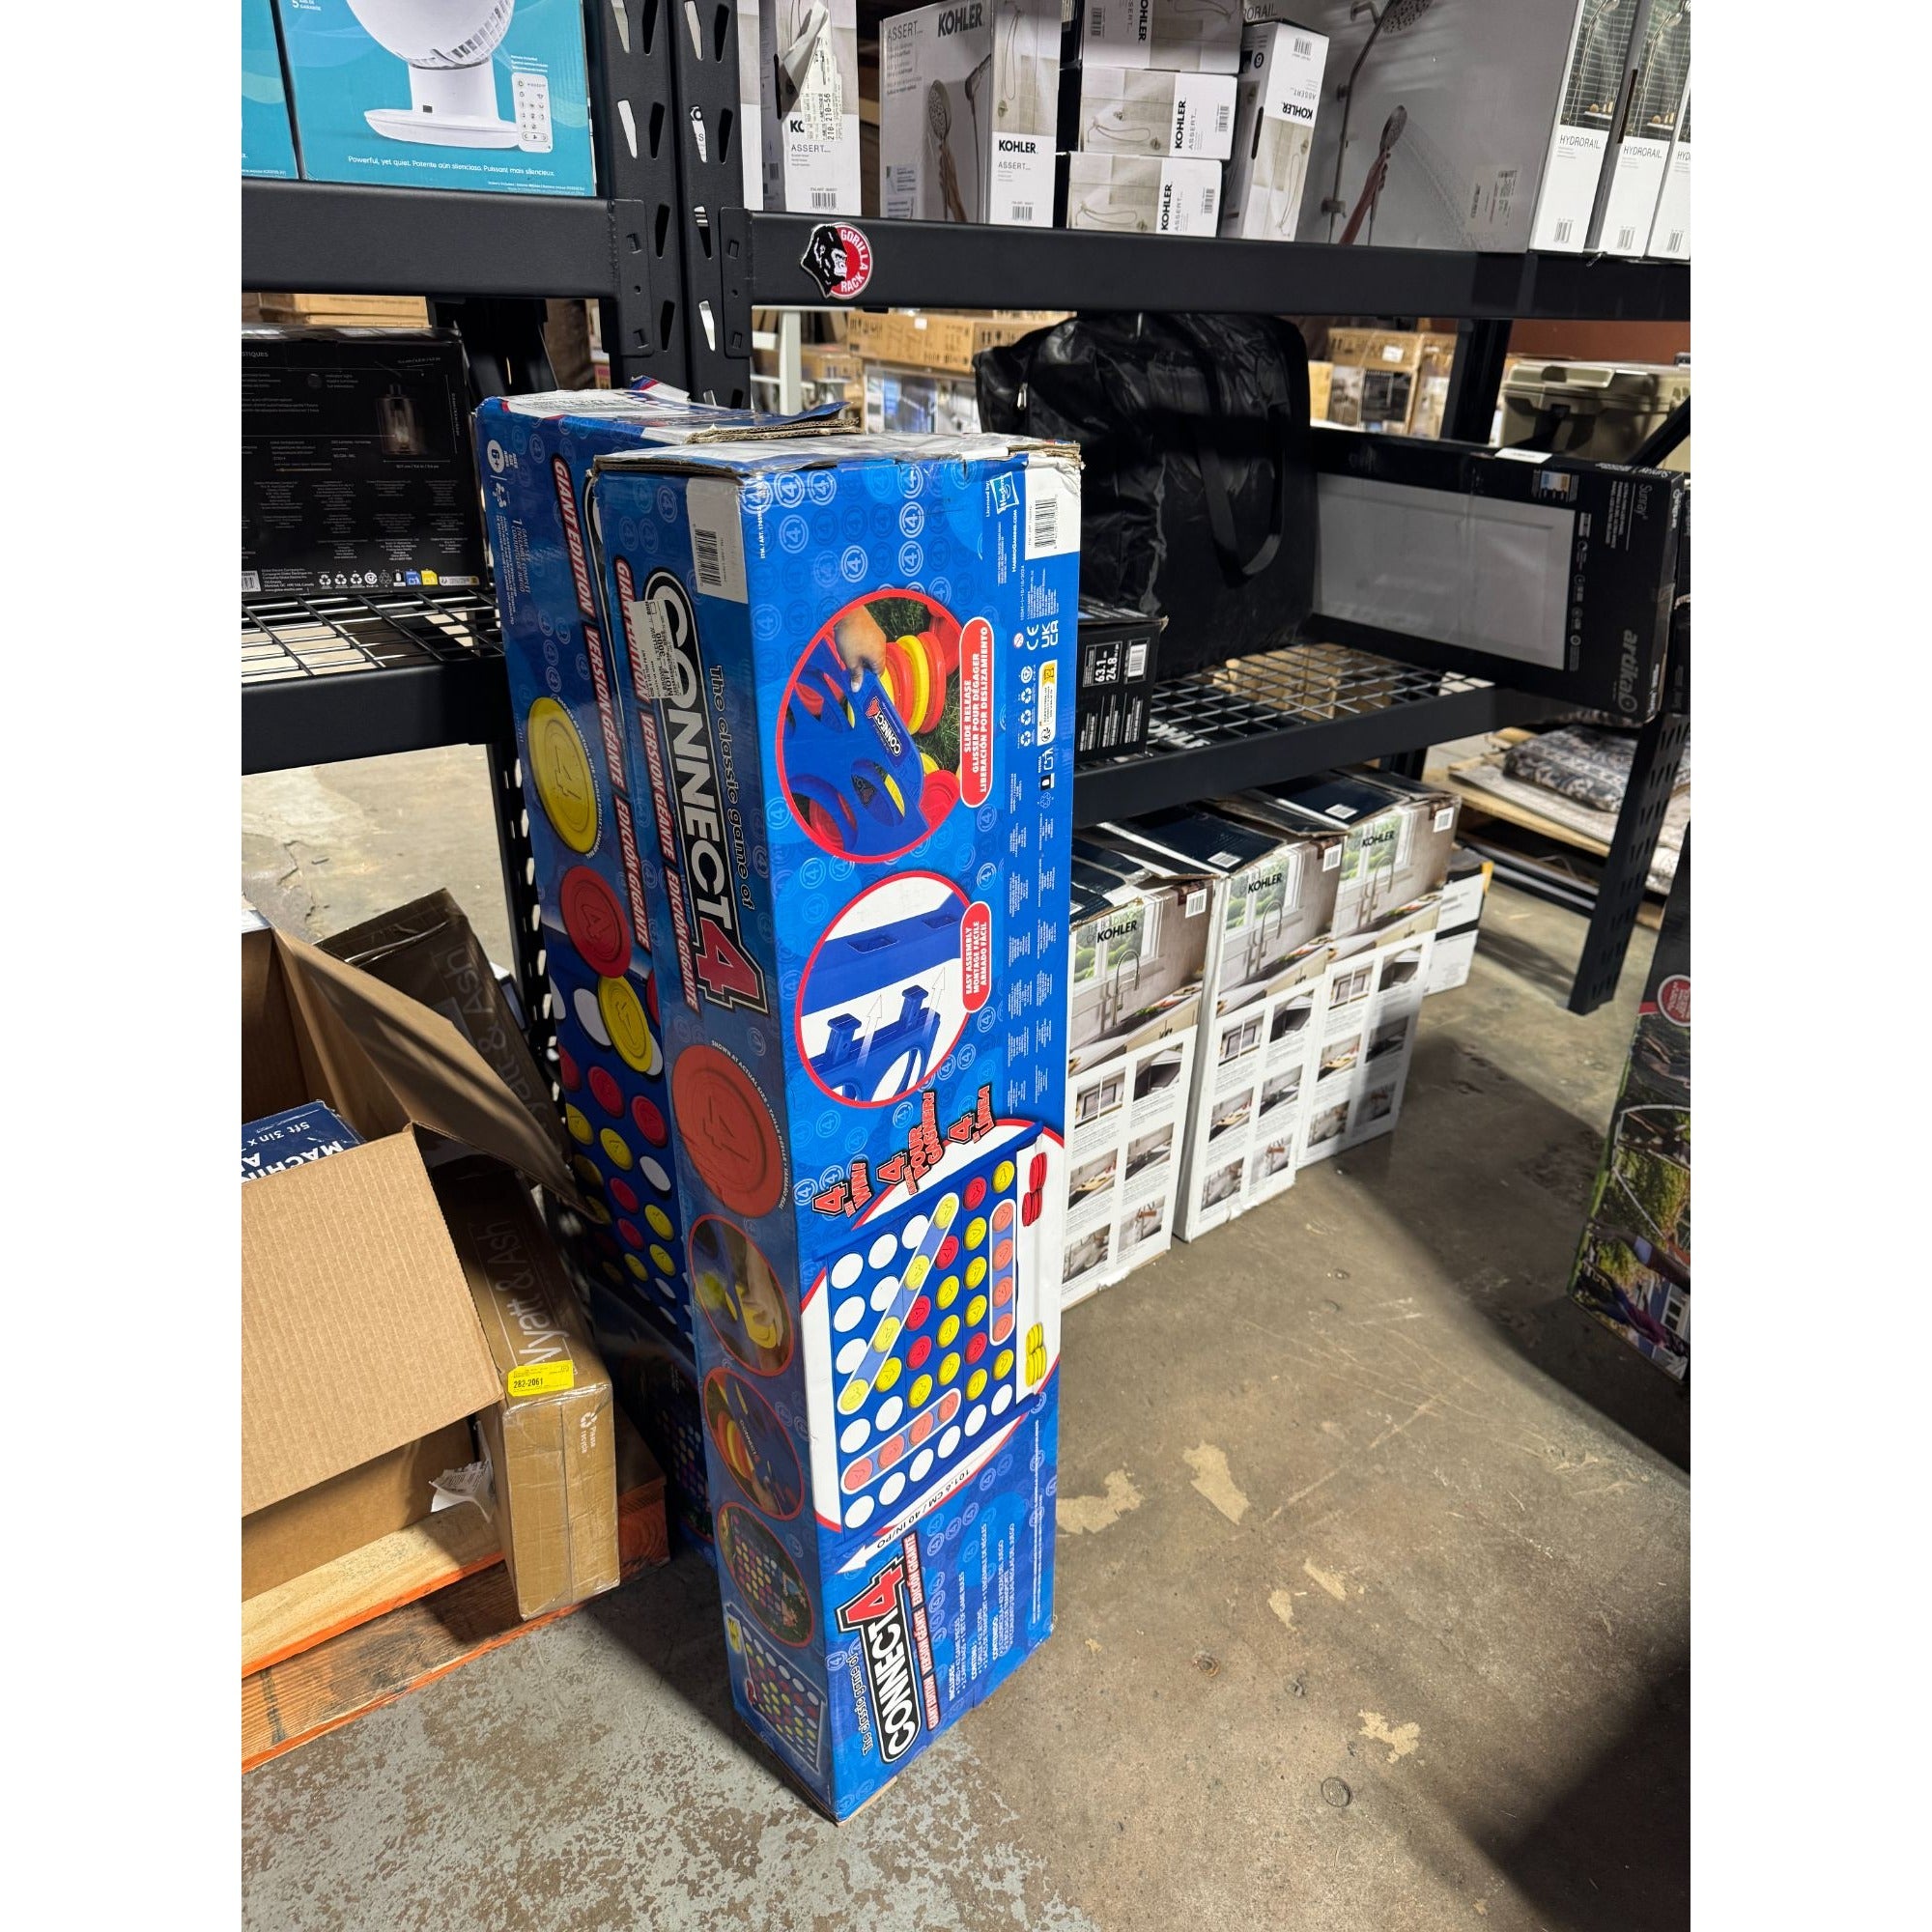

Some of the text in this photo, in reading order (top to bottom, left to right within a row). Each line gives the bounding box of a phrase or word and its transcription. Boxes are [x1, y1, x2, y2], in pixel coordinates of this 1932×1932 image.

[888, 20, 918, 40] ASSERT
[938, 3, 982, 38] KOHLER
[1138, 0, 1149, 41] OHLER
[1175, 99, 1186, 149] KOHLER
[1282, 101, 1314, 120] KOHLER
[999, 139, 1037, 154] KOHLER
[1560, 134, 1601, 149] HYDRORAIL
[1623, 146, 1662, 158] HYDRORAIL
[348, 156, 380, 165] Powerful,
[412, 159, 437, 168] Potente
[484, 164, 508, 174] Puissant
[998, 161, 1026, 170] ASSERT
[1161, 184, 1172, 231] KOHLER
[840, 229, 868, 270] GORILLA
[840, 271, 866, 293] RACK
[1635, 484, 1652, 518] Sunray
[554, 461, 595, 618] GIANT EDITION
[972, 653, 980, 700] DÉGAGER
[1095, 659, 1107, 682] 63.1
[1106, 657, 1118, 681] 24.8
[585, 627, 626, 791] VERSION GÉANTE
[874, 711, 900, 753] CONNECT
[640, 714, 668, 801] VERSION
[655, 802, 675, 860] GÉANTE
[653, 584, 759, 999] CONNECT 4
[710, 666, 754, 910] The classic game of
[1361, 830, 1395, 847] KOHLER
[615, 796, 651, 952] EDICIÓN GIGANTE
[1247, 872, 1283, 894] KOHLER
[667, 868, 699, 1013] EDICIÓN GIGANTE
[1097, 920, 1137, 943] KOHLER
[712, 1040, 731, 1056] SHOWN
[738, 1062, 757, 1087] ACTUAL
[757, 1086, 768, 1103] SIZE
[769, 1109, 781, 1134] TAILLE
[264, 1127, 285, 1143] 3in
[288, 1121, 310, 1137] 5ft
[909, 1127, 930, 1179] POUR
[922, 1091, 944, 1165] GAGNER!
[949, 1116, 973, 1142] 4
[878, 1155, 905, 1182] 4
[814, 1186, 846, 1213] 4
[850, 1162, 871, 1208] WIN!
[479, 1220, 527, 1266] Ash
[496, 1270, 534, 1292] &
[513, 1378, 543, 1389] 282-2061
[924, 1492, 944, 1509] CM
[877, 1521, 907, 1548] IN/PO
[903, 1533, 924, 1606] EDICIÓN GIGANTE
[847, 1562, 916, 1755] CONNECT 4
[914, 1607, 934, 1676] VERSION GÉANTE
[850, 1666, 867, 1694] game
[856, 1696, 871, 1730] classic
[924, 1675, 940, 1729] GIANT EDITION
[861, 1731, 875, 1756] The
